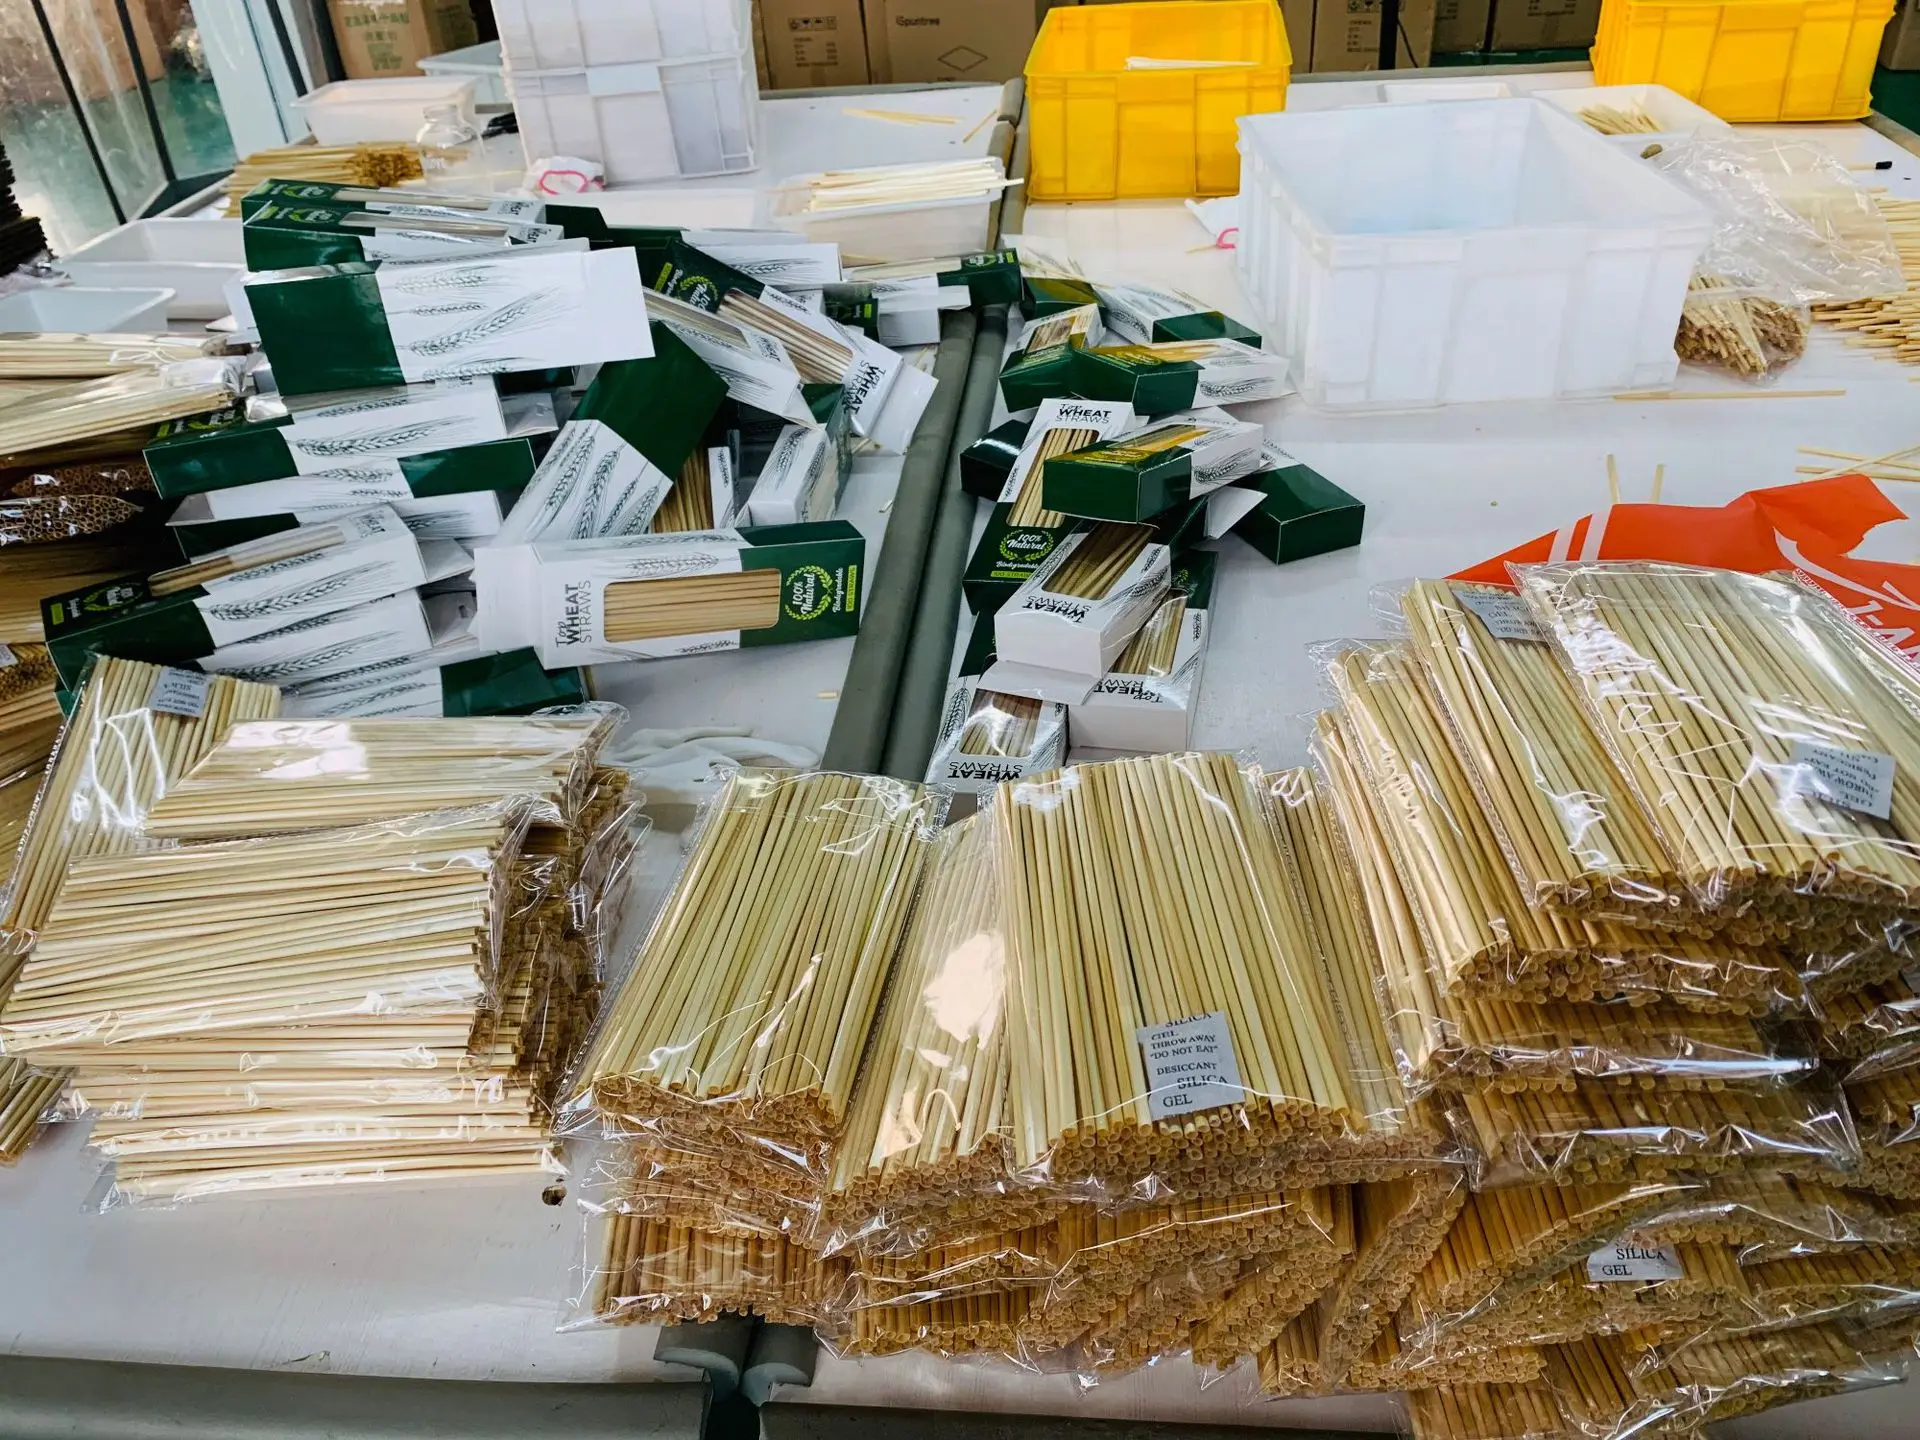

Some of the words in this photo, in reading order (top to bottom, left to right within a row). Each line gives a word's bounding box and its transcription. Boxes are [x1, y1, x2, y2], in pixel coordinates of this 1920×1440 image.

[850, 365, 880, 415] WHEAT
[1055, 415, 1110, 424] STRAWS
[1059, 409, 1112, 417] WHEAT
[1006, 539, 1048, 550] Natural
[1017, 534, 1043, 542] 100%
[996, 561, 1039, 570] Biodegradabl
[792, 581, 804, 605] 100%
[800, 573, 816, 614] Natural
[578, 580, 592, 643] STRAWS
[1022, 601, 1086, 619] WHEAT
[1025, 596, 1092, 613] STRAWS
[564, 584, 580, 646] WHEAT
[555, 621, 568, 648] Top
[1134, 694, 1163, 703] Top
[949, 762, 1024, 773] STRAWS
[948, 770, 1020, 781] WHEAT
[1151, 1037, 1187, 1050] THROW
[1188, 1034, 1216, 1044] AWAY
[1172, 1046, 1193, 1056] NOT
[1156, 1061, 1218, 1075] DESICCANT
[1176, 1074, 1229, 1090] SILICA
[1163, 1093, 1193, 1108] GEL
[1602, 1264, 1633, 1276] GEL
